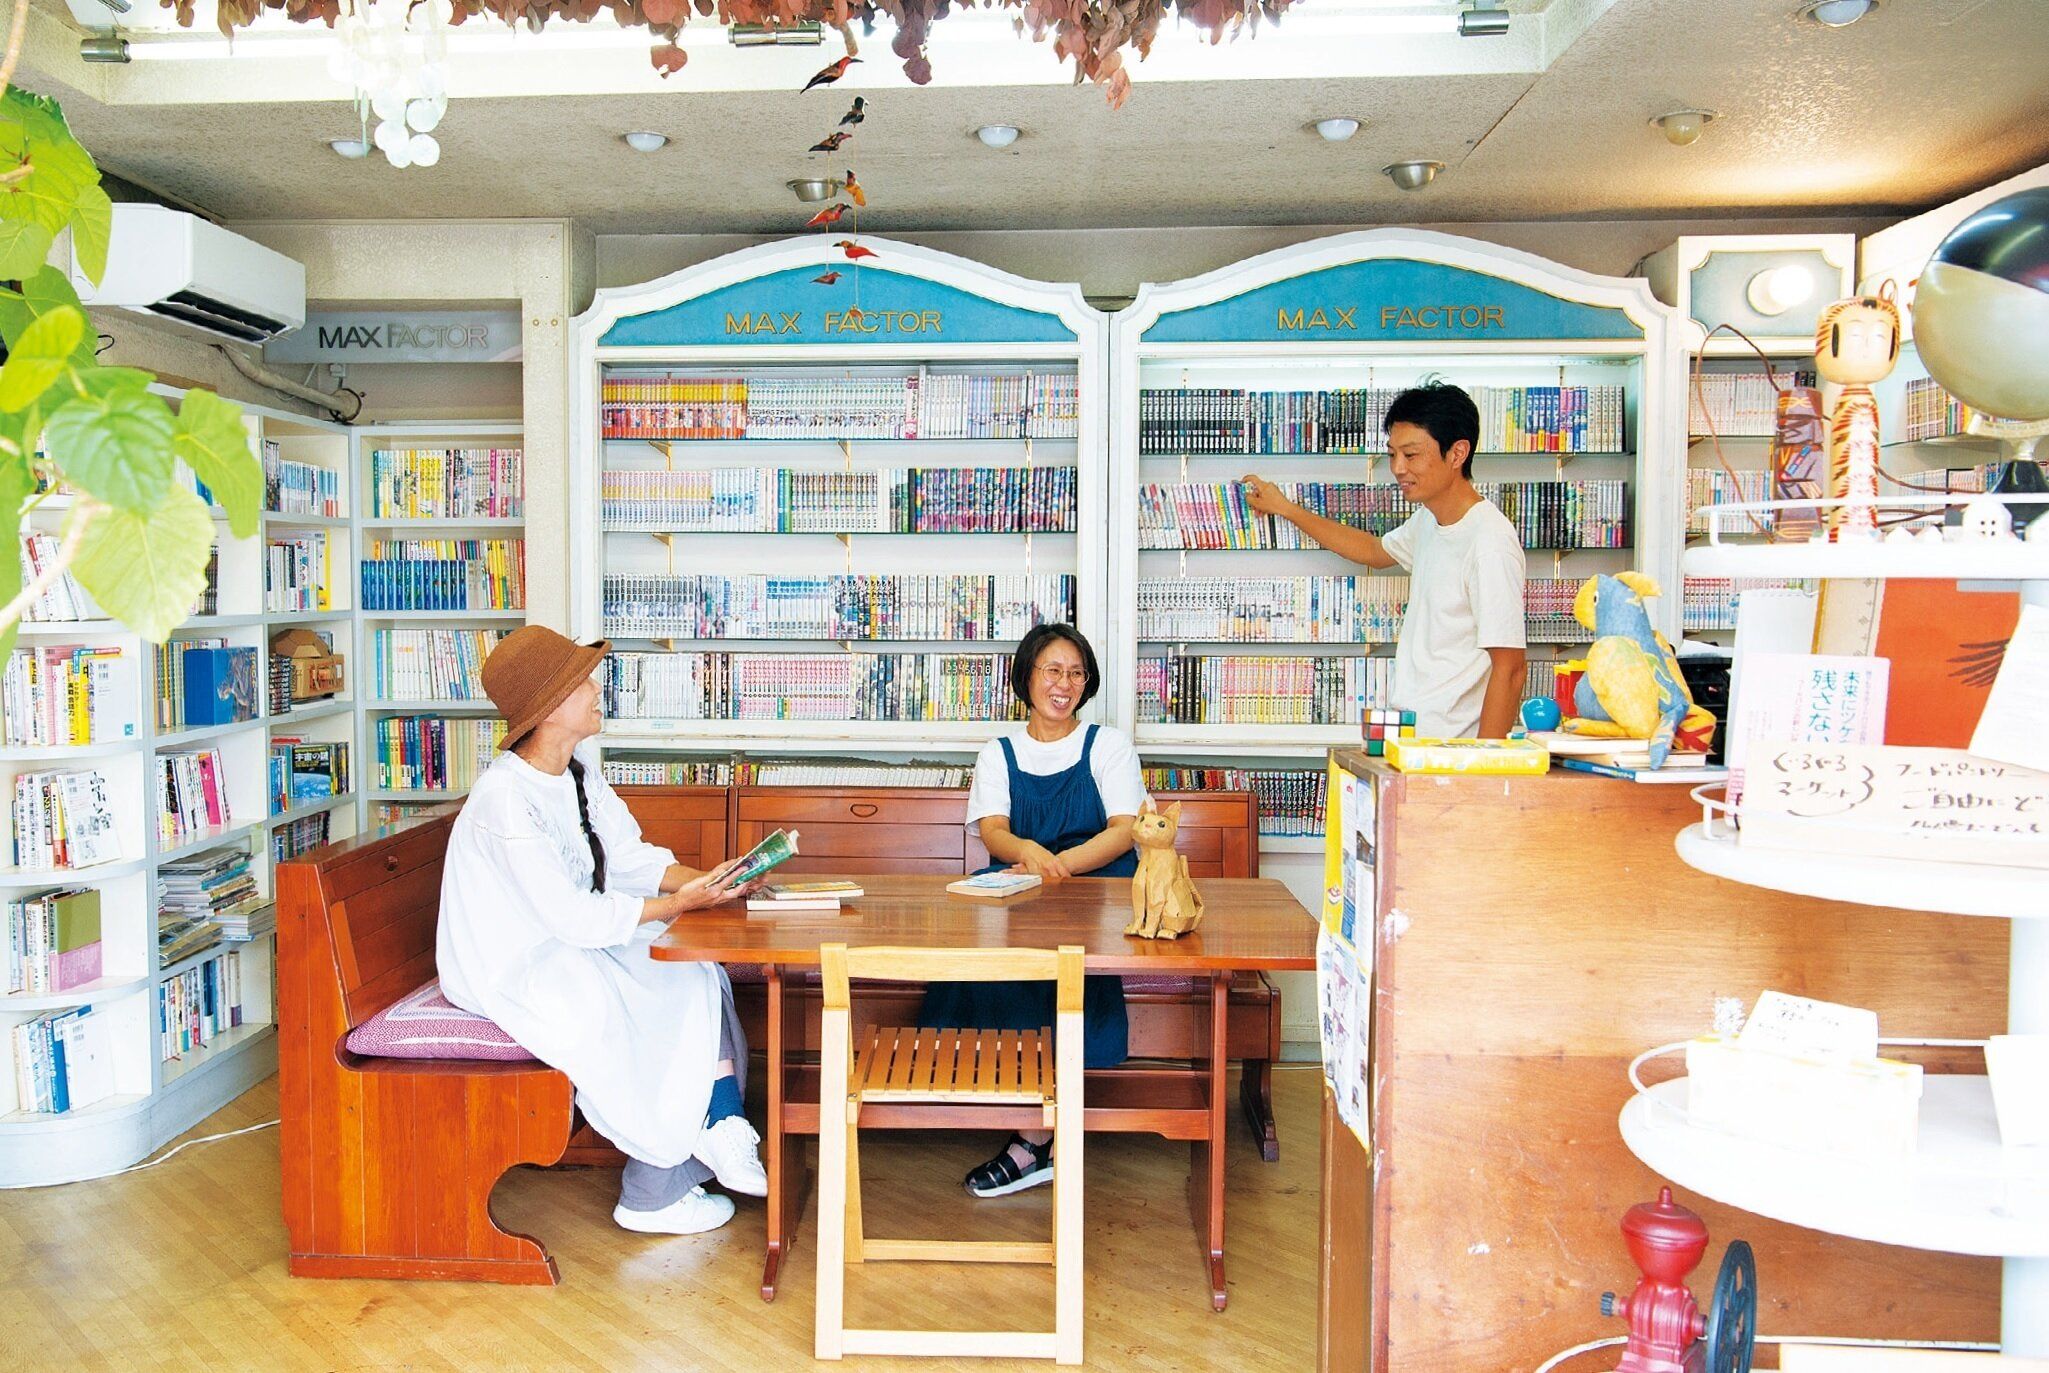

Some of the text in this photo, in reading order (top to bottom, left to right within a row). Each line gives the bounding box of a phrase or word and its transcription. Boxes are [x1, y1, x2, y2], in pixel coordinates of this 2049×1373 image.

[724, 310, 944, 335] MAX FACTOR
[1277, 305, 1505, 331] MAX FACTOR
[318, 322, 490, 349] MAX FACTOR
[1839, 671, 1860, 743] 未来にツケ
